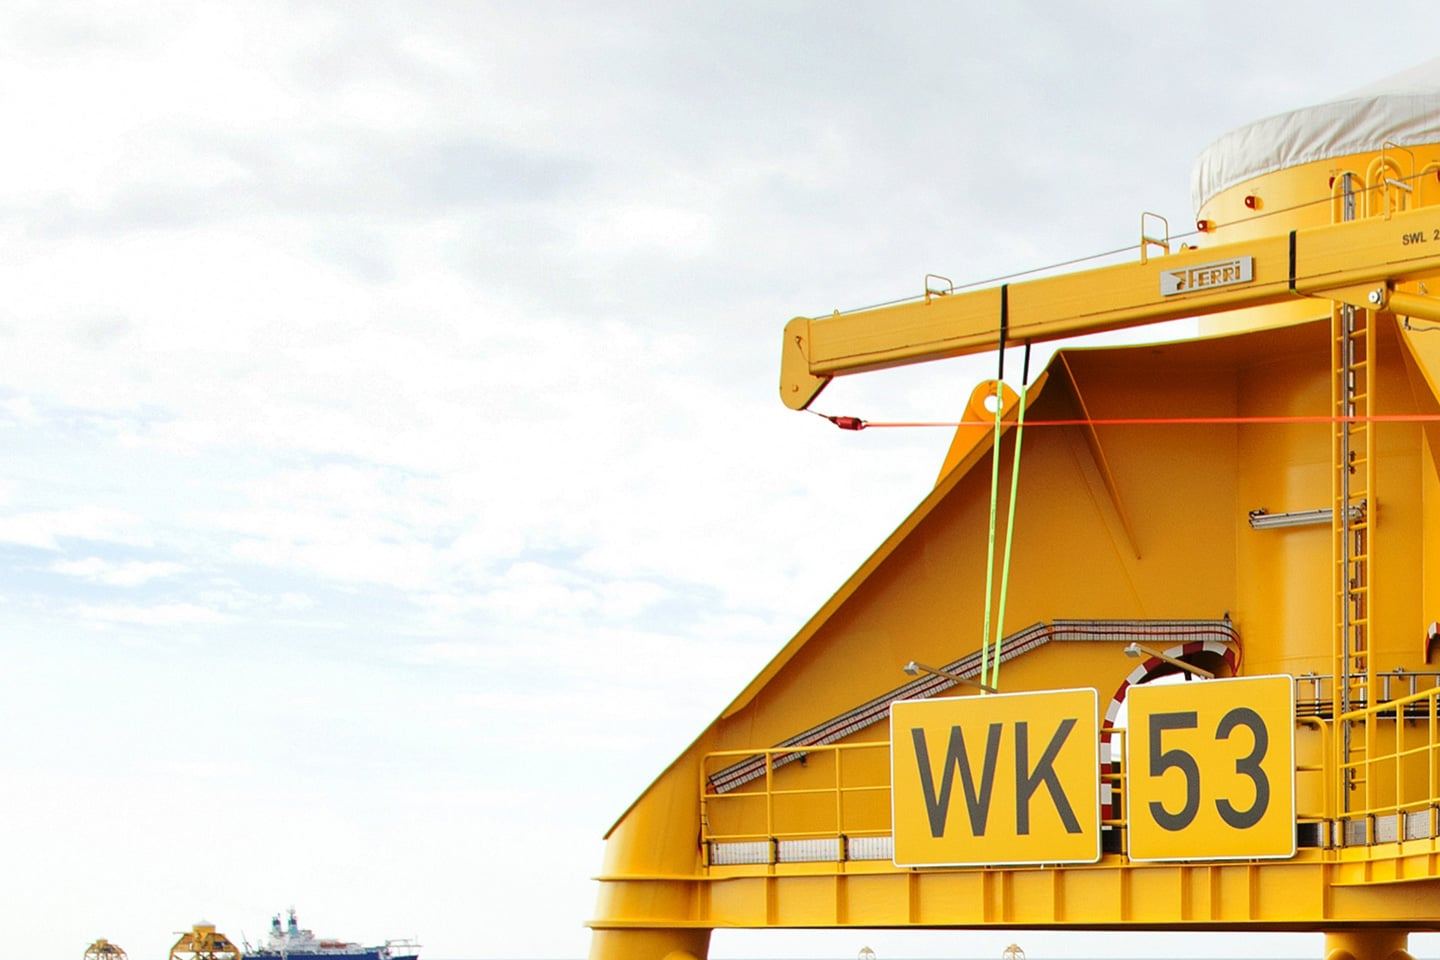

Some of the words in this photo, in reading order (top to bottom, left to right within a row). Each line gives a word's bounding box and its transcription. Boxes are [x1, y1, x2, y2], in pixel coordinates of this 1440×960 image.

[1402, 231, 1427, 246] SWL
[911, 718, 1084, 839] WK
[1148, 707, 1271, 832] 53
